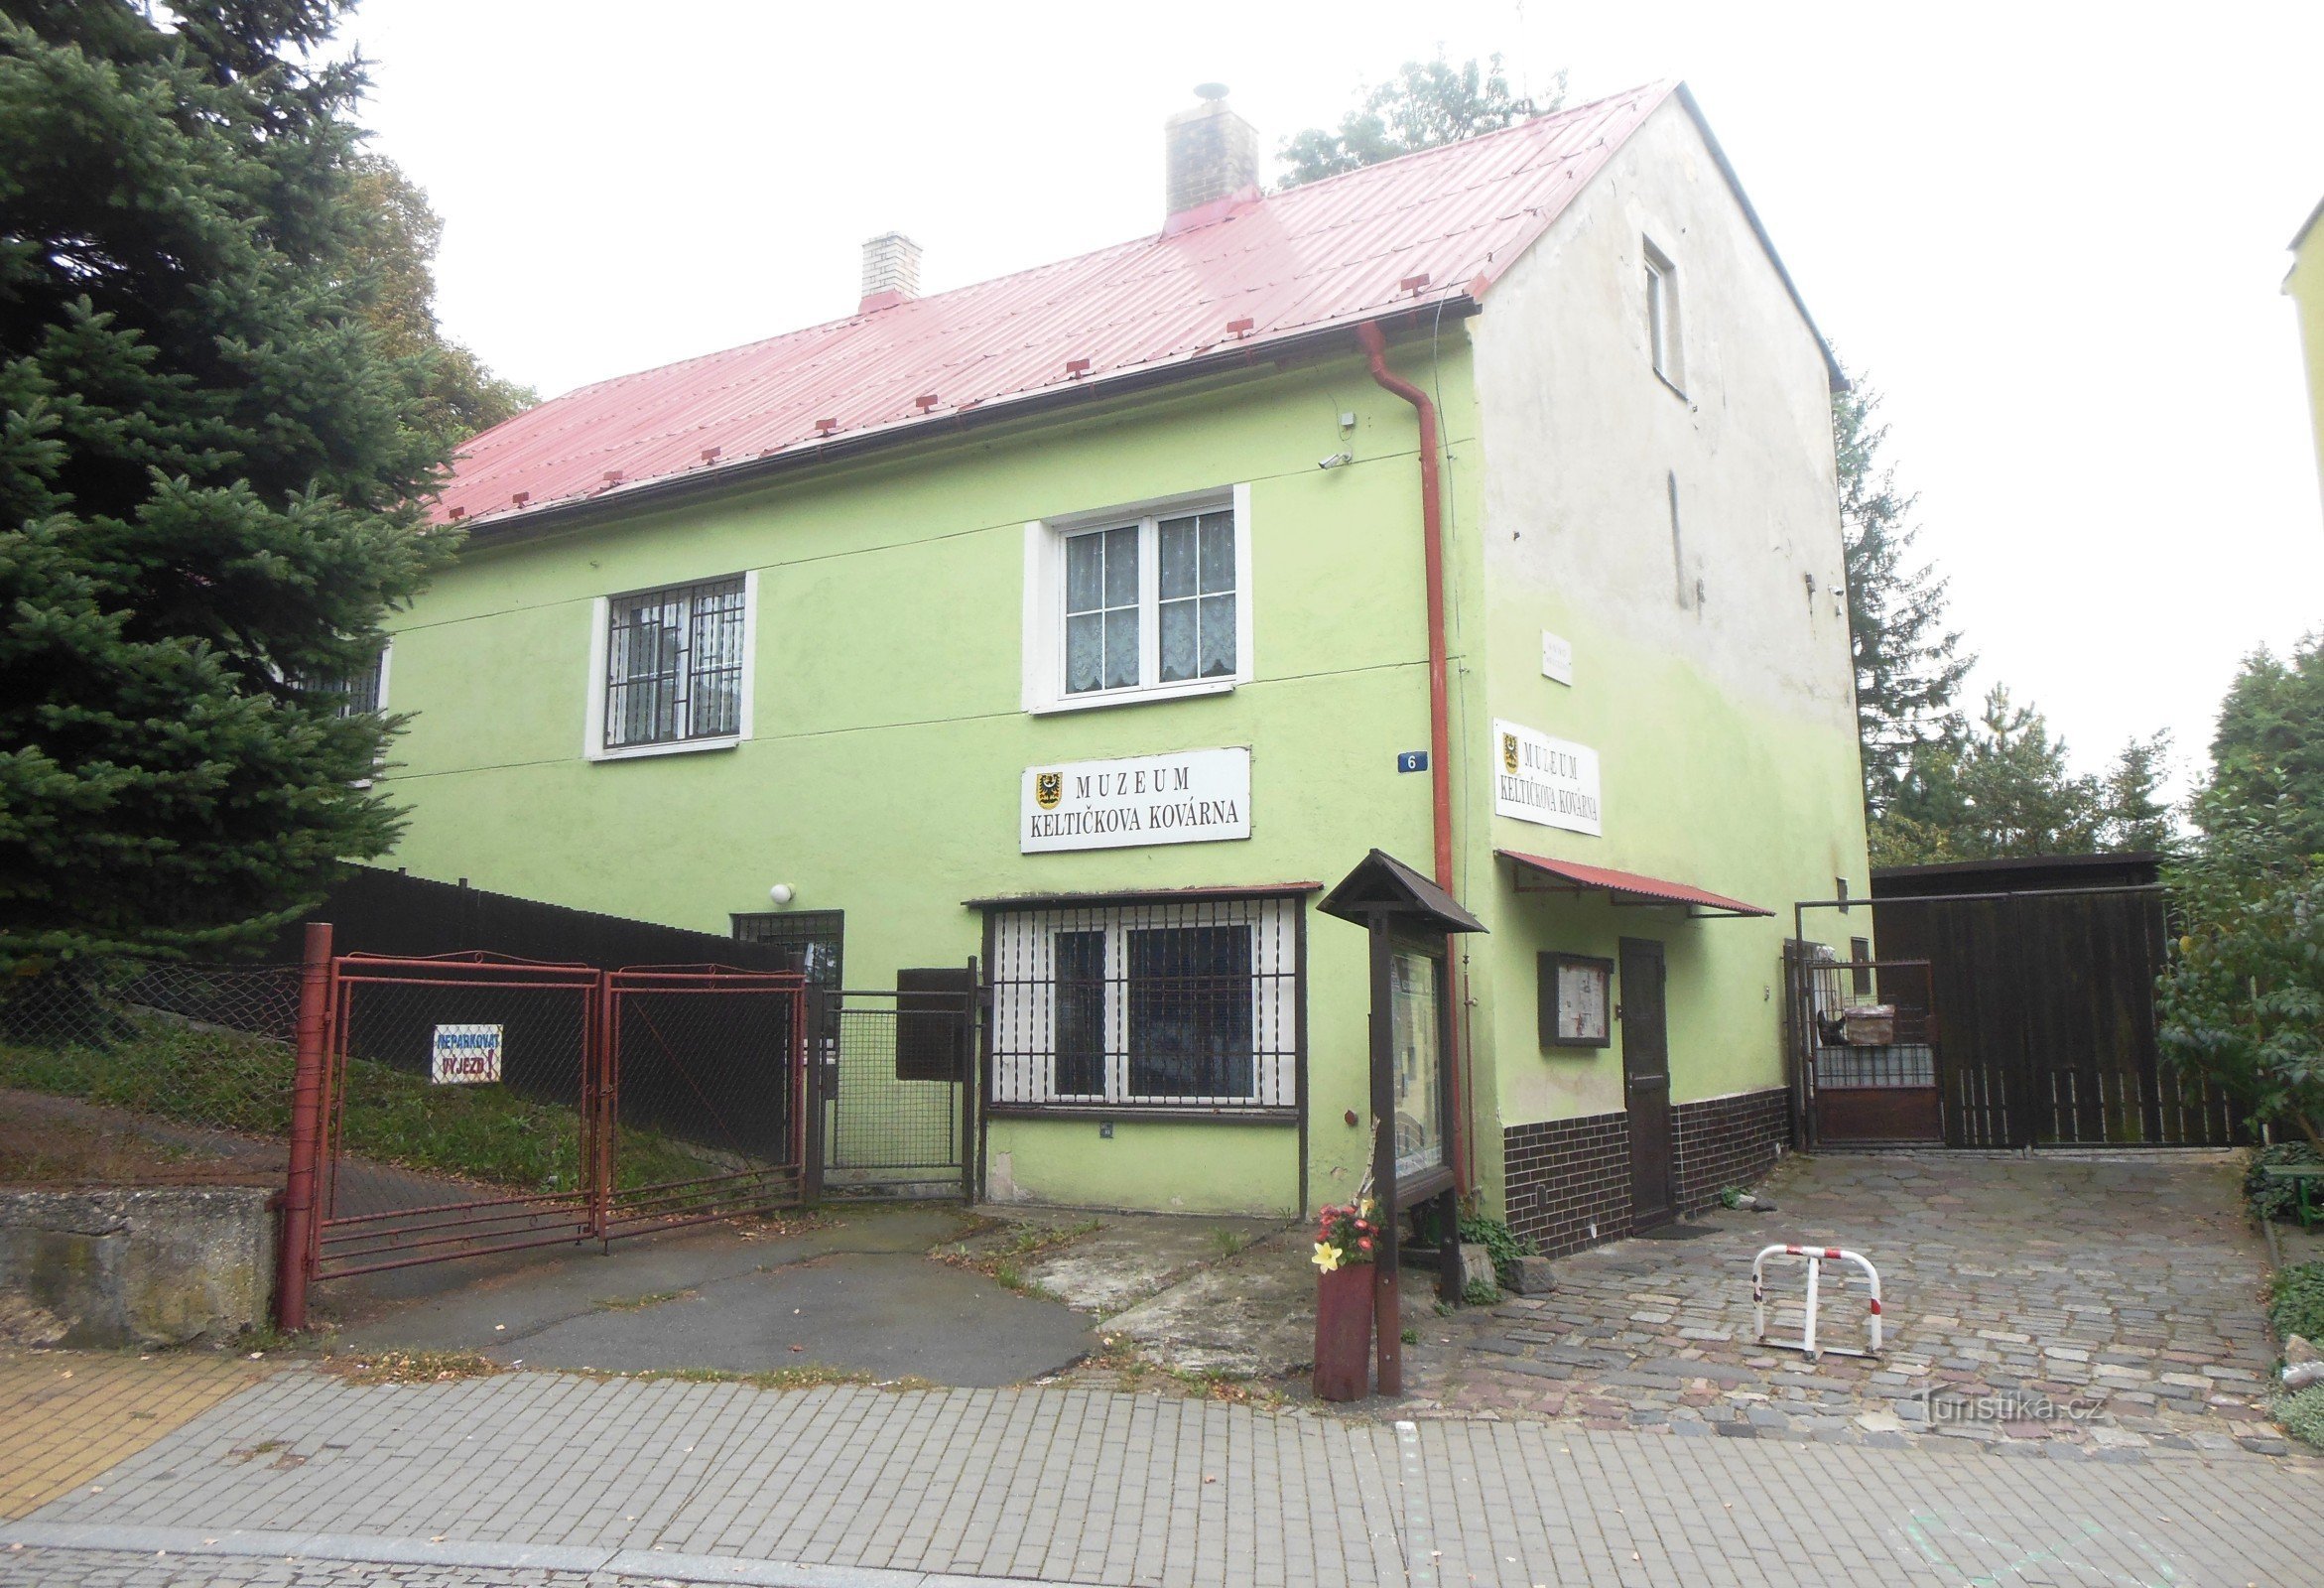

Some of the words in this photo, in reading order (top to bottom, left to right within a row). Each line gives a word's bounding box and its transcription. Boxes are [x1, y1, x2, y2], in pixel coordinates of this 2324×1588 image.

[1407, 755, 1416, 769] 6
[1524, 741, 1577, 780] MUZEUM
[1076, 766, 1190, 799] MUZEUM
[1500, 774, 1556, 812] KELTIČKOVA
[1559, 787, 1597, 821] KOVÁRNA
[1030, 805, 1141, 838] KELTIČKOVA
[1148, 796, 1239, 829] KOVÁRNA
[437, 1033, 500, 1049] NEPARKOVAT
